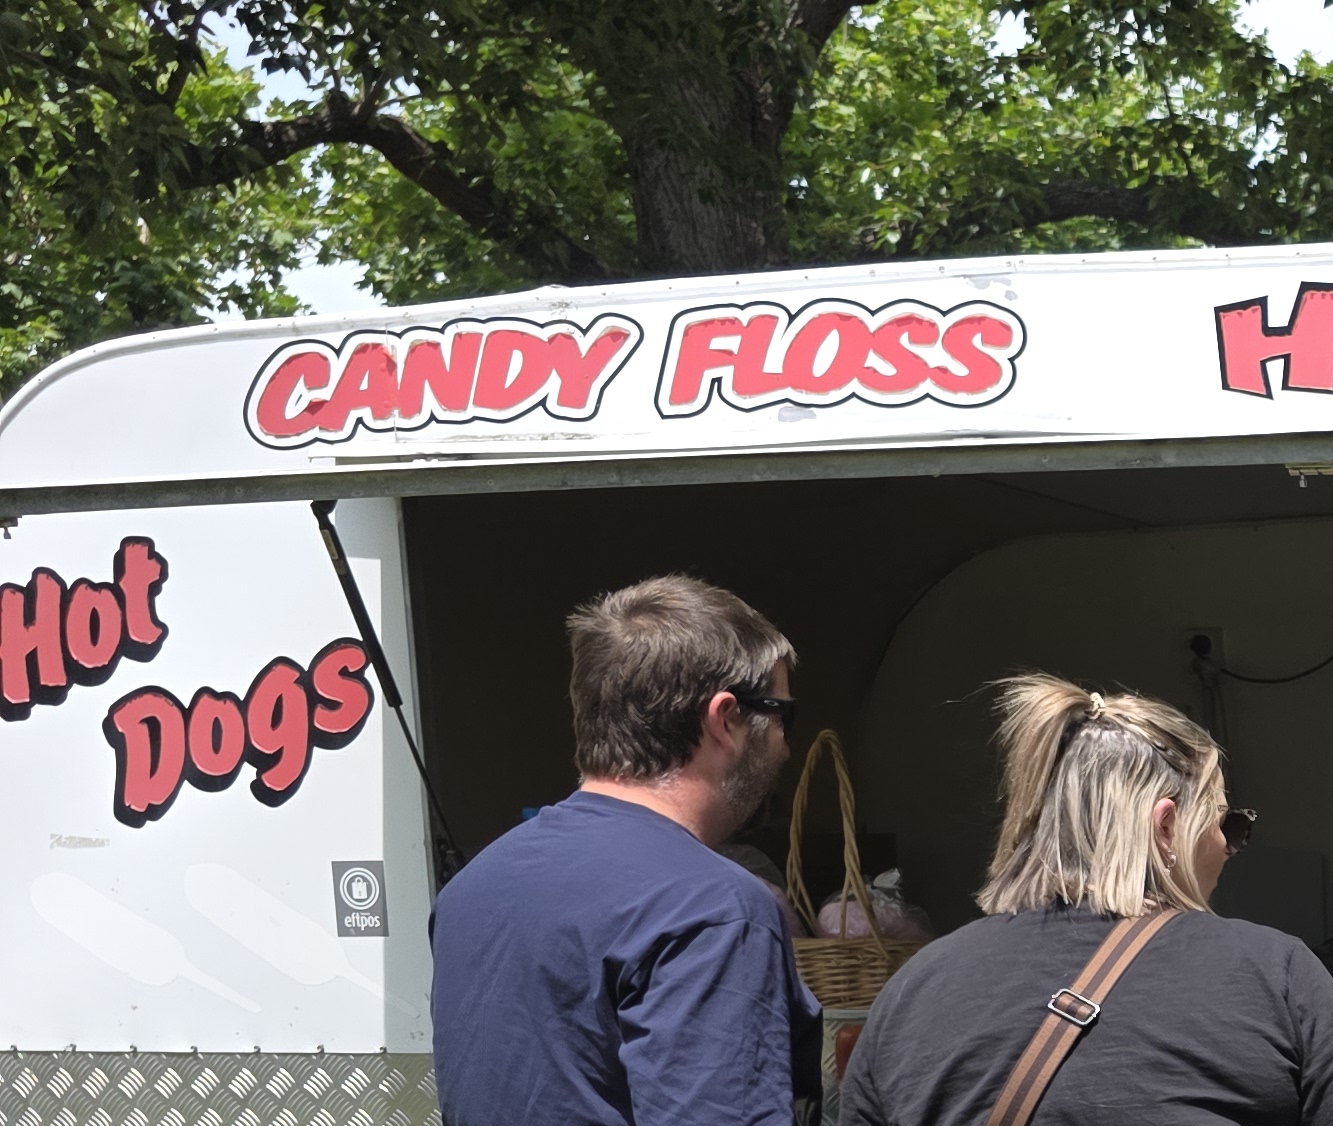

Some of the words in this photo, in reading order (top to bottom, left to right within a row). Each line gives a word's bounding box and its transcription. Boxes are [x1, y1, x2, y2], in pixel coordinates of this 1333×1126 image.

[244, 313, 642, 450] CANDY
[656, 298, 1026, 418] FLOSS
[0, 535, 169, 722] Hot
[104, 638, 373, 827] Dogs
[344, 912, 381, 931] eftpos
